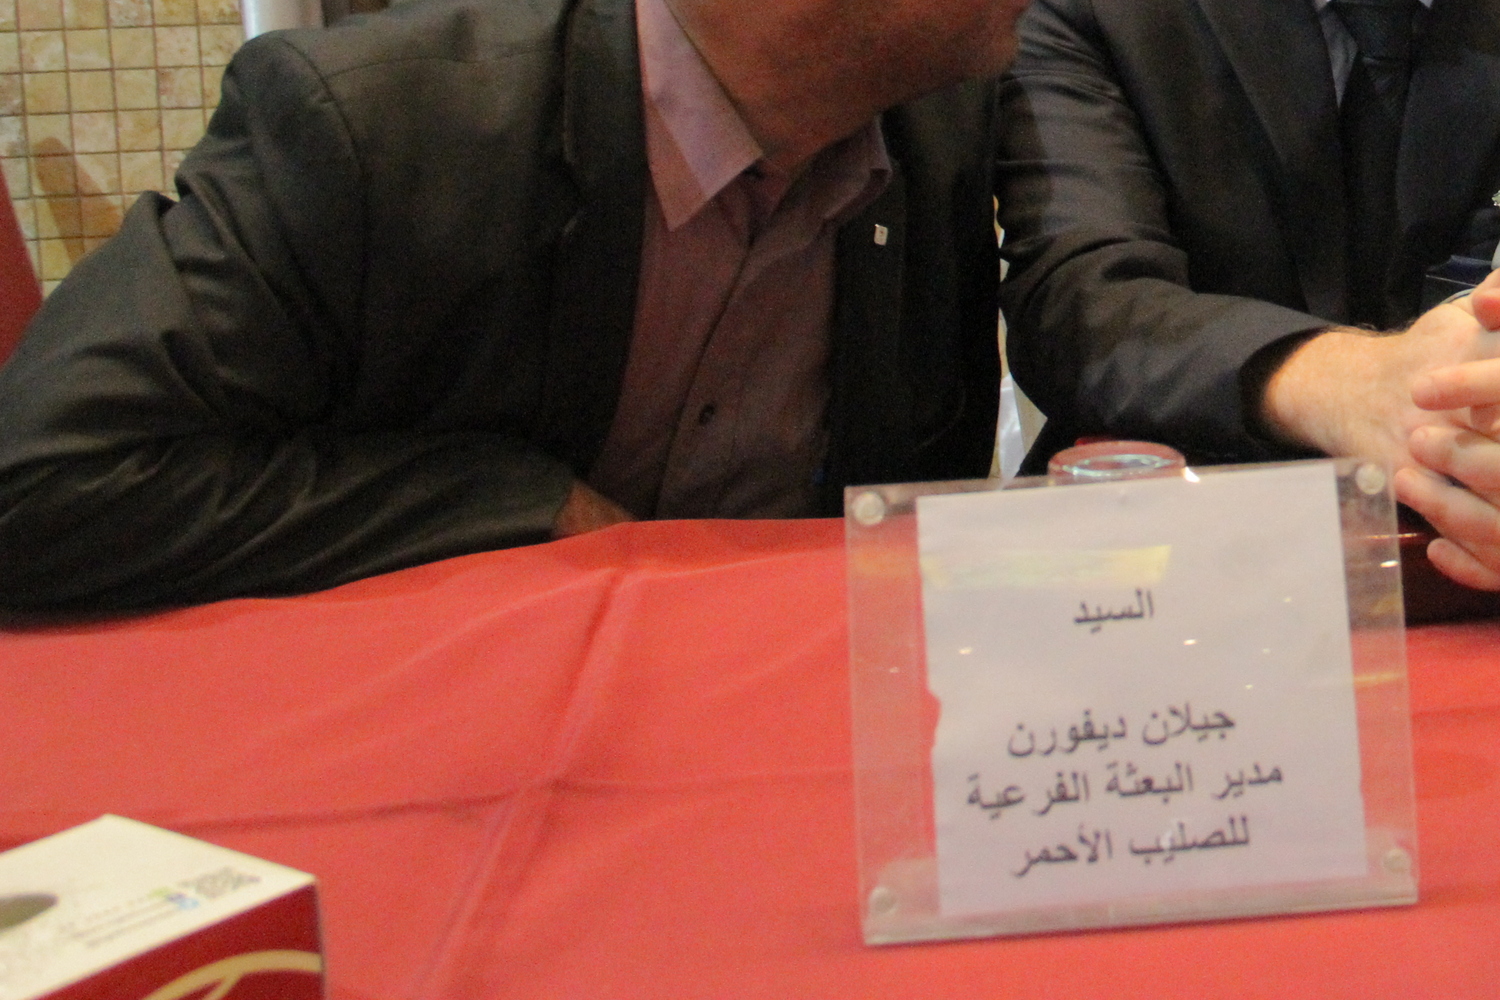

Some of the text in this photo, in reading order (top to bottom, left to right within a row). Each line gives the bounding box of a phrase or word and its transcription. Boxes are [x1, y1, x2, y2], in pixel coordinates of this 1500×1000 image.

[1074, 588, 1154, 634] السيد
[1007, 702, 1235, 757] جيلان ديفورن
[967, 760, 1283, 821] مدير البعثة الفرعية
[1013, 814, 1250, 878] للصليب الأحمر
